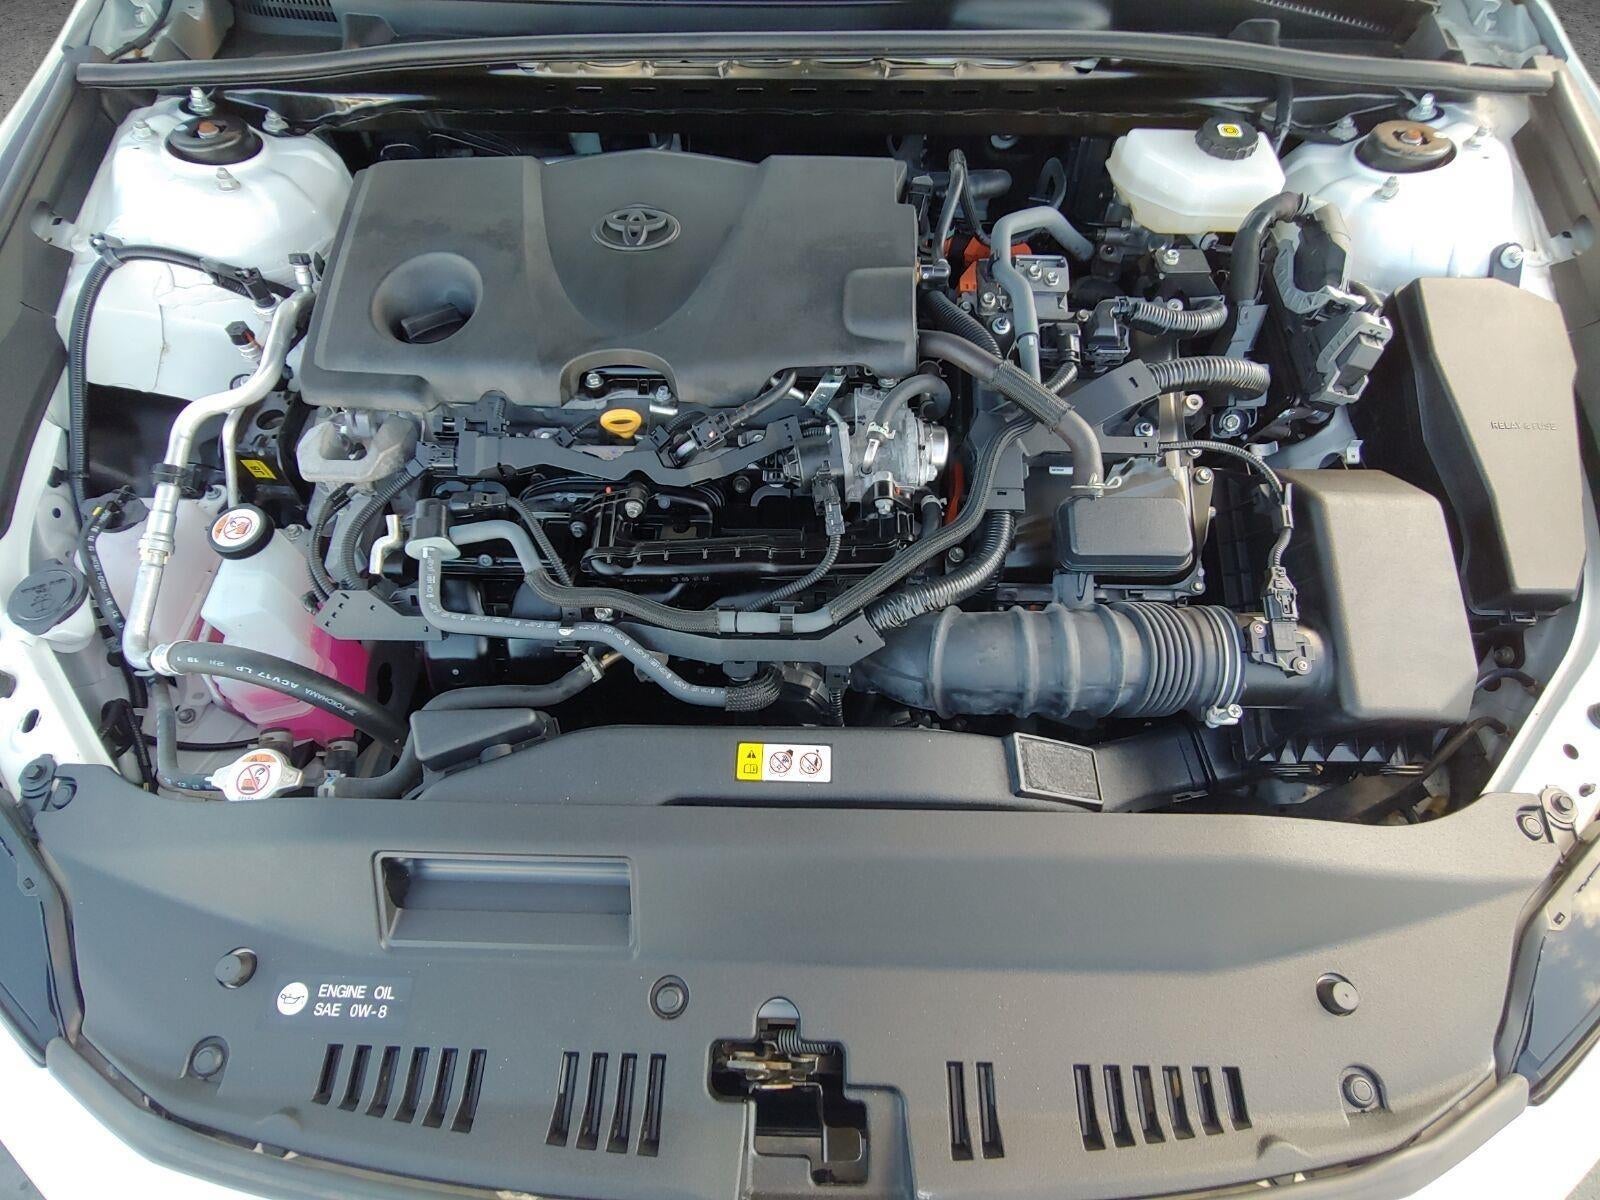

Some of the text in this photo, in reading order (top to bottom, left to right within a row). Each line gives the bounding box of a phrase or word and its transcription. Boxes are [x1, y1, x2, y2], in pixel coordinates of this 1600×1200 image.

[1490, 421, 1520, 430] RELAY
[1531, 422, 1557, 431] FUSE
[235, 666, 253, 674] LP
[257, 671, 300, 690] ACV17
[304, 687, 347, 712] YOKOHAMA
[318, 983, 395, 1000] ENGINE OIL
[313, 1003, 388, 1018] SAE 0W-8
